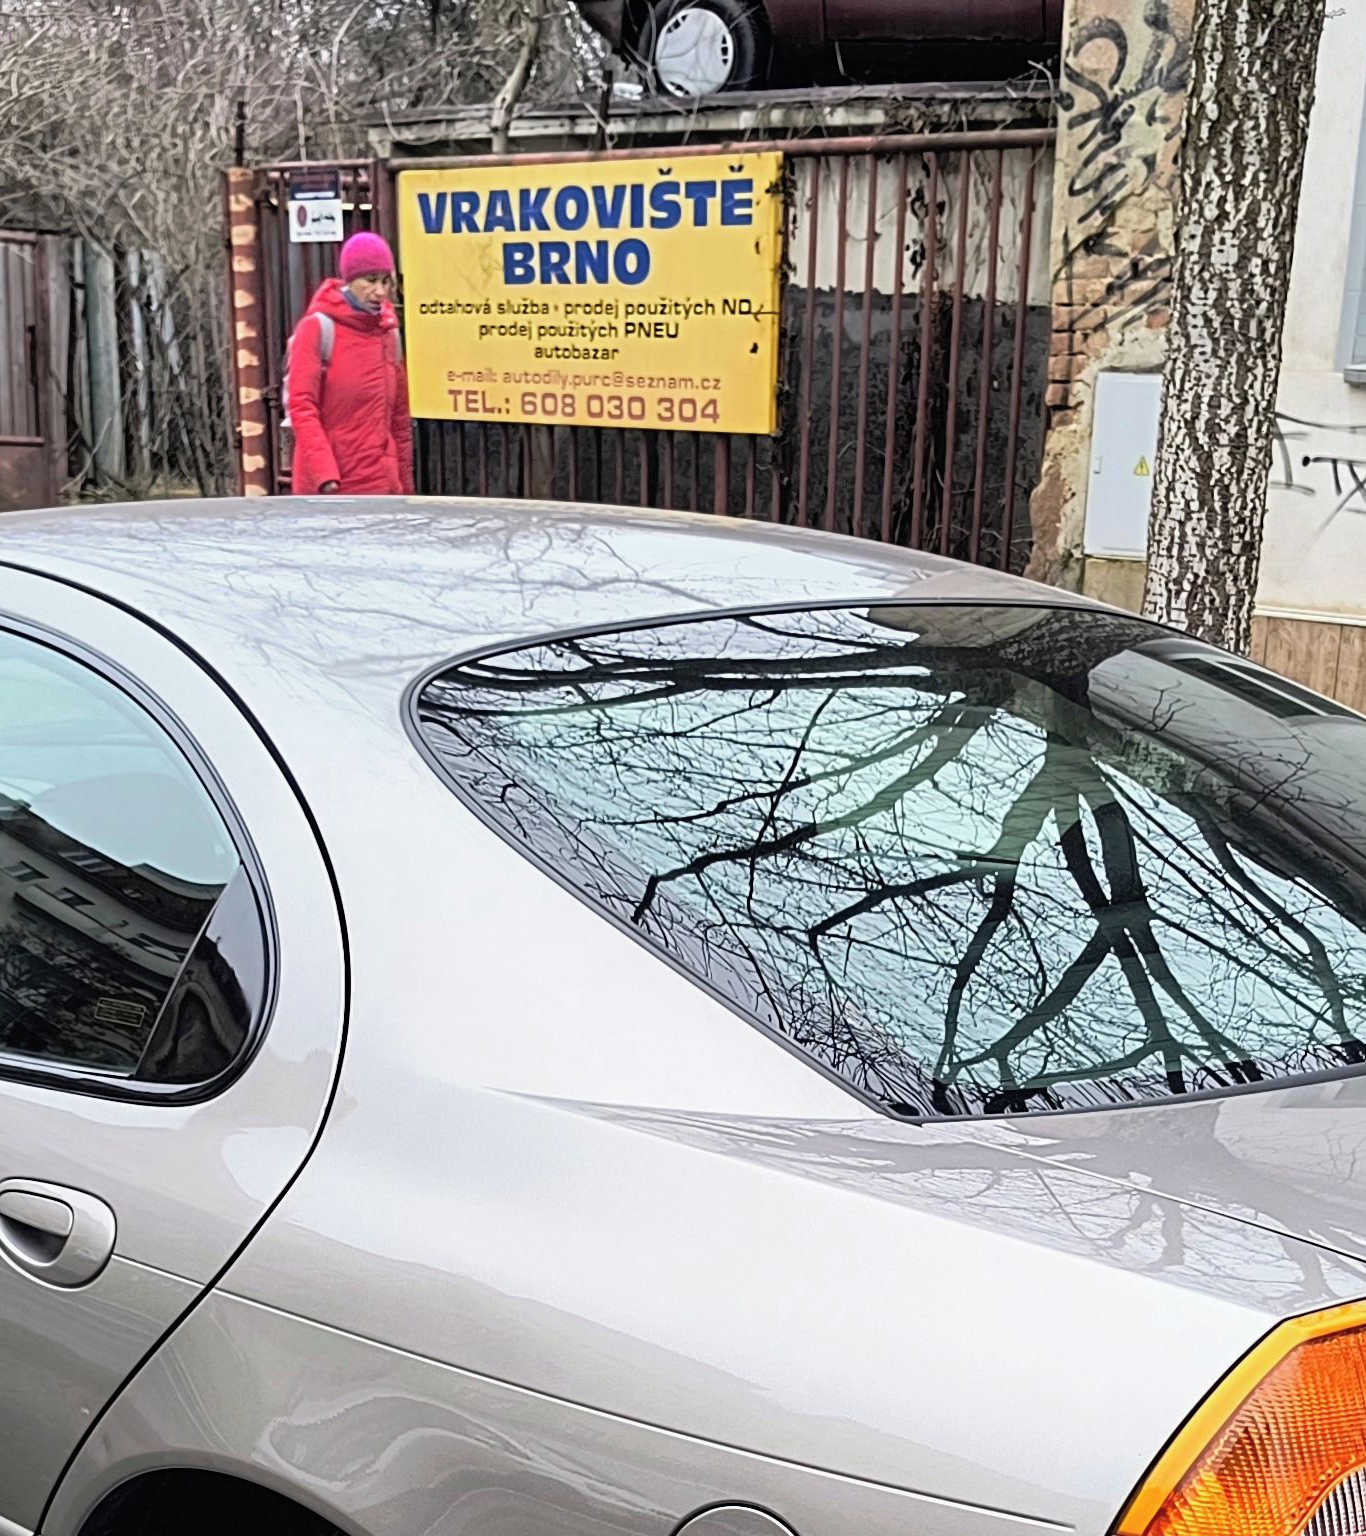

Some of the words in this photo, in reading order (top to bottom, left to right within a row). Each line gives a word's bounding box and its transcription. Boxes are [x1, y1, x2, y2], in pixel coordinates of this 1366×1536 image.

[417, 164, 753, 234] VRAKOVIŠTĚ
[502, 238, 651, 286] BRNO
[419, 298, 492, 315] odtahová
[497, 297, 550, 315] služba
[564, 298, 619, 320] prodej
[625, 297, 716, 321] použitých
[479, 321, 532, 341] prodej
[537, 320, 619, 342] použitých
[624, 322, 680, 339] PNEU
[534, 344, 620, 360] autobazar
[447, 368, 498, 383] e-mail:
[448, 389, 510, 415] TEL.:
[521, 392, 576, 418] 608
[586, 394, 646, 421] 030
[657, 397, 720, 424] 304
